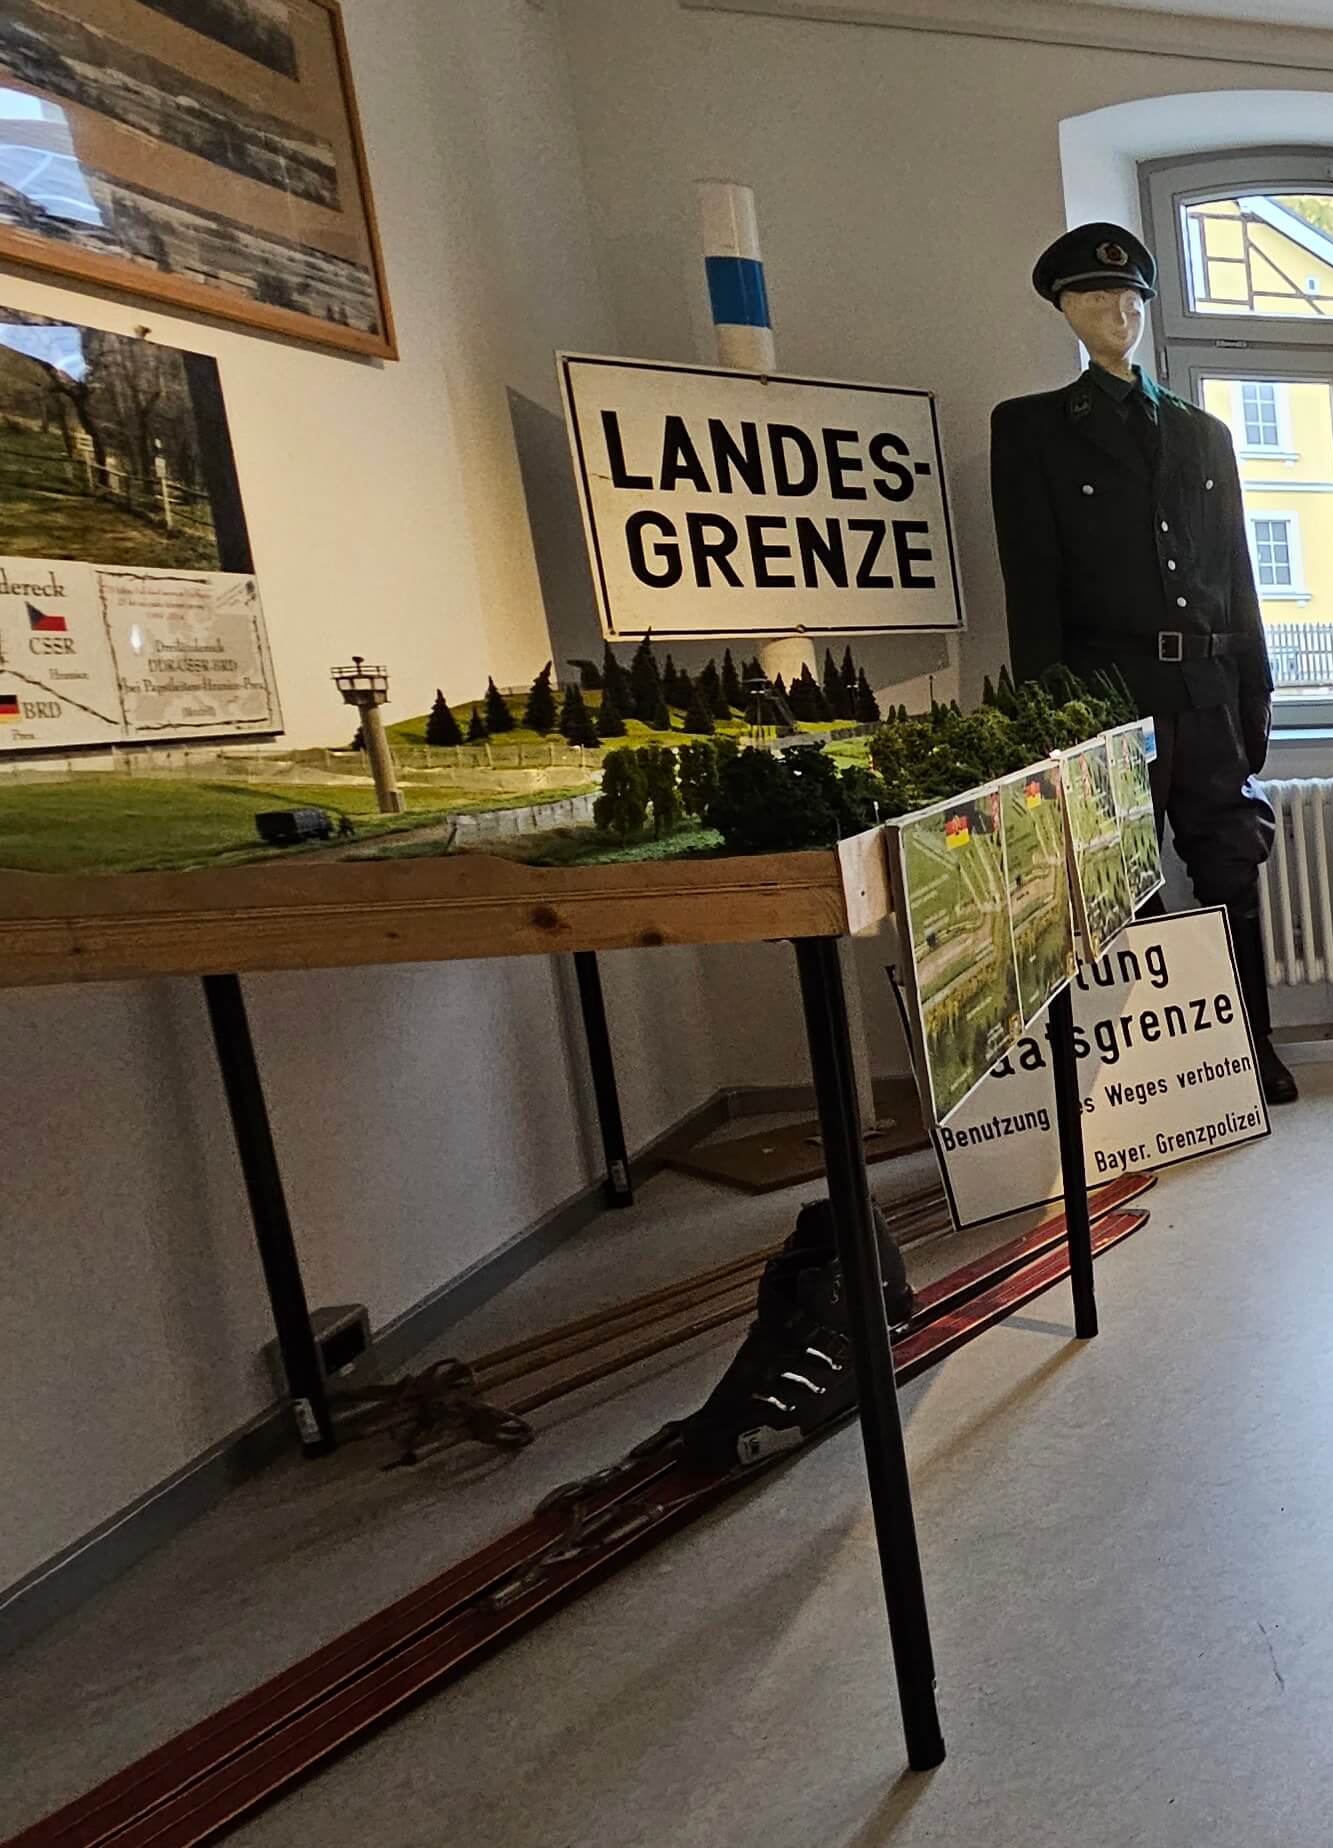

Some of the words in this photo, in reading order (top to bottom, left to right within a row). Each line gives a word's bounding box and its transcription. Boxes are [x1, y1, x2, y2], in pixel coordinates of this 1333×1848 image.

[600, 410, 931, 503] LANDES-
[625, 510, 936, 590] GRENZE
[23, 702, 62, 720] BRD
[1074, 944, 1169, 991] tung
[941, 1108, 1051, 1151] Benutzung
[1104, 1076, 1168, 1107] Weges
[1176, 1055, 1251, 1089] verboten
[1095, 1144, 1151, 1173] Bayer.
[1156, 1105, 1261, 1154] Grenzpolizei
